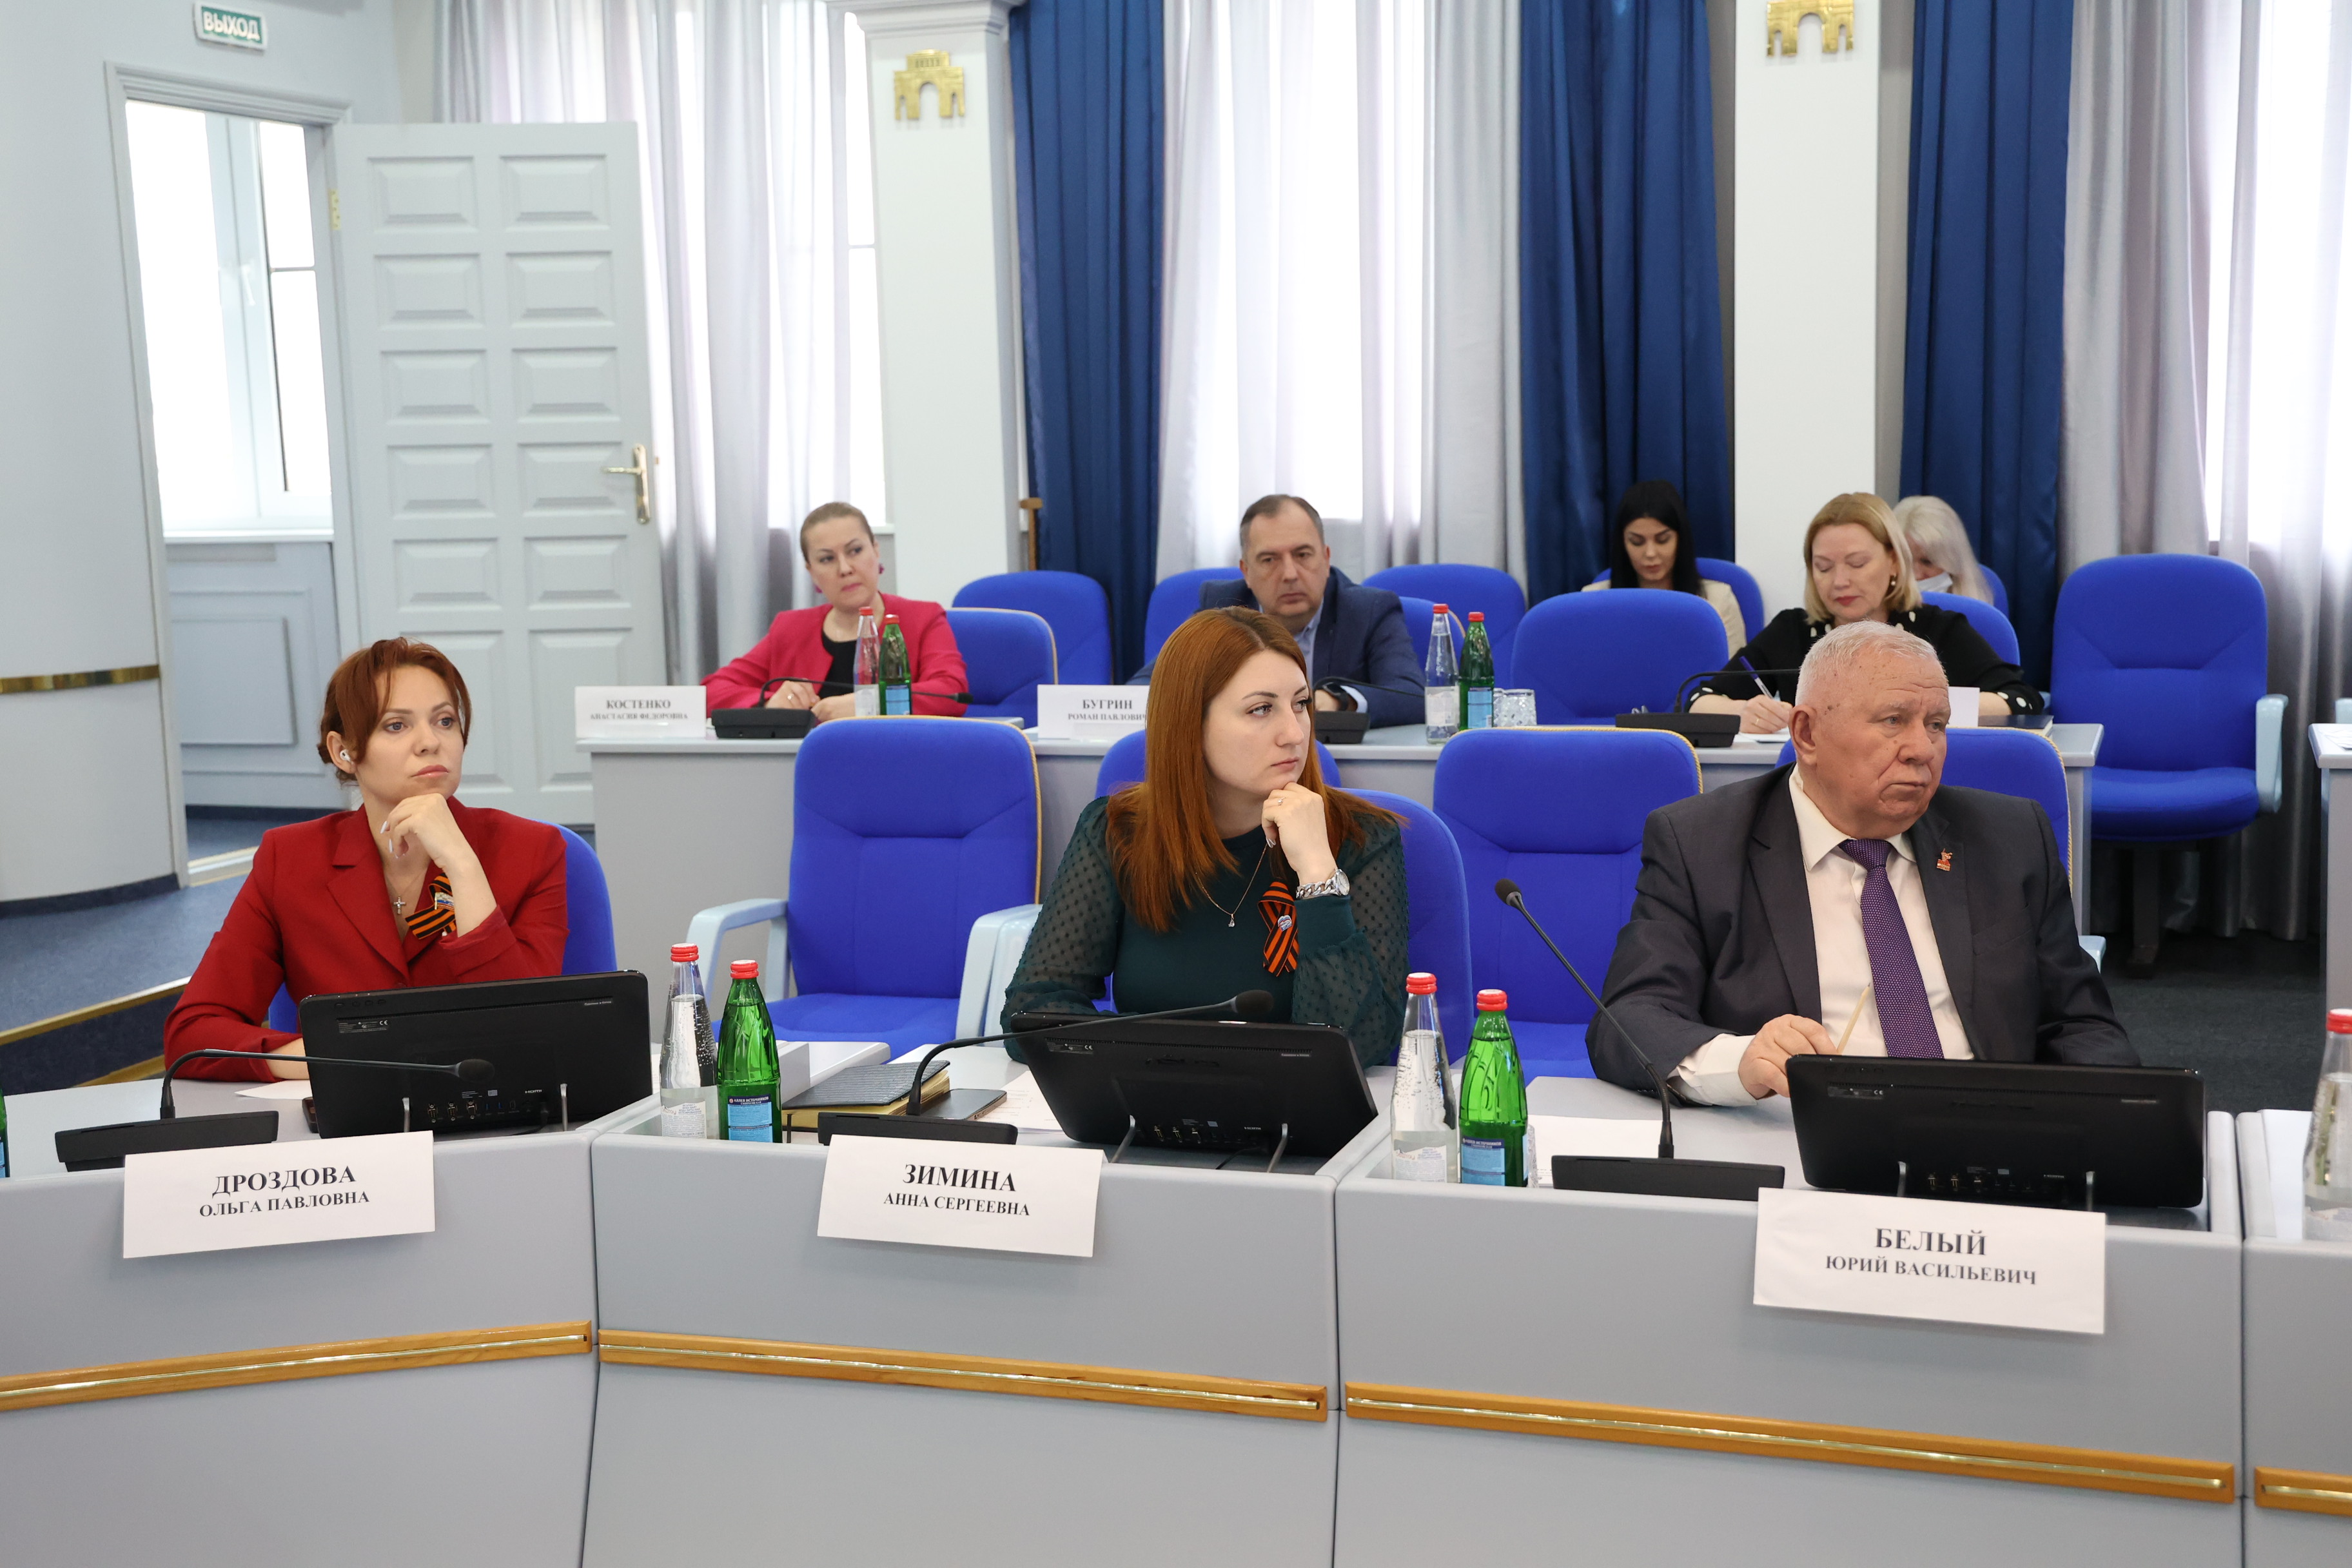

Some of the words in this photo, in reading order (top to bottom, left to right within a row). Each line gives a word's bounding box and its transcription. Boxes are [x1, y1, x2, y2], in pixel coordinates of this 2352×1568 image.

[203, 11, 260, 41] ВЫХОД
[606, 699, 671, 710] КОСТЕНКО
[1083, 699, 1133, 710] БУГРИН
[211, 1165, 357, 1199] ДРОЗДОВА
[903, 1164, 1016, 1192] ЗИМИНА
[199, 1200, 262, 1217] ОЛЬГА
[268, 1191, 370, 1211] ПАВЛОВНА
[883, 1192, 930, 1208] АННА
[934, 1196, 1030, 1216] СЕРГЕЕВНА
[1874, 1228, 1986, 1256] БЕЛЫЙ
[1825, 1255, 1888, 1273] ЮРИЙ
[1894, 1261, 2036, 1286] ВАСИЛЬЕВИЧ
